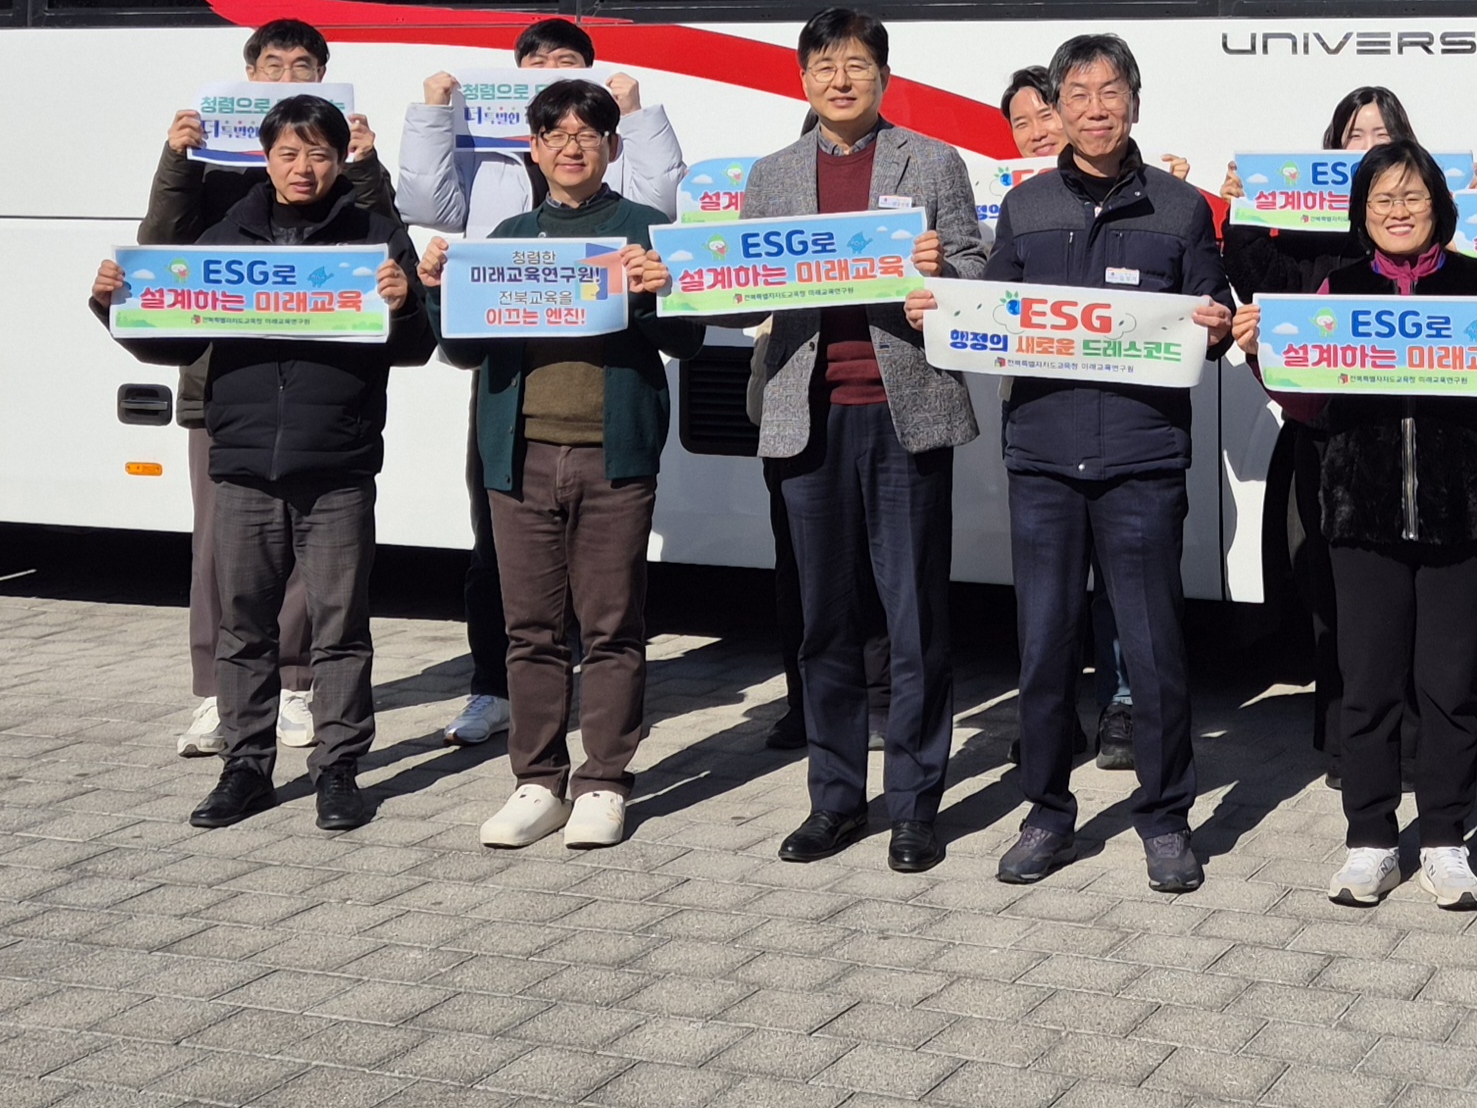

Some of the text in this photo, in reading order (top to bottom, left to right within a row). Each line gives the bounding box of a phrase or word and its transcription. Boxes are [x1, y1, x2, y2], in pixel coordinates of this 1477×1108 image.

[463, 83, 530, 101] 청렴으로
[201, 96, 271, 115] 청렴으로
[1311, 161, 1360, 185] ES
[1254, 190, 1349, 211] 설계하는
[740, 230, 837, 259] ESG로
[512, 250, 556, 265] 청렴한
[203, 259, 297, 286] ESG로
[470, 266, 600, 283] 미래교육연구원!
[678, 255, 904, 293] 설계하는 미래교육
[139, 287, 363, 313] 설계하는 미래교육
[499, 291, 573, 305] 전북교육을
[808, 287, 854, 297] 미래교육연구원
[486, 307, 586, 325] 이끄는 엔진!
[1019, 297, 1112, 334] ESG
[1351, 309, 1453, 339] ESG로
[949, 329, 1182, 363] 행정의 새로운 드레스코드
[1282, 343, 1397, 369] 설계하는
[1007, 359, 1134, 373] 전북특별자치도교육청 미래교육연구원
[1418, 376, 1468, 385] 미래교육연구원
